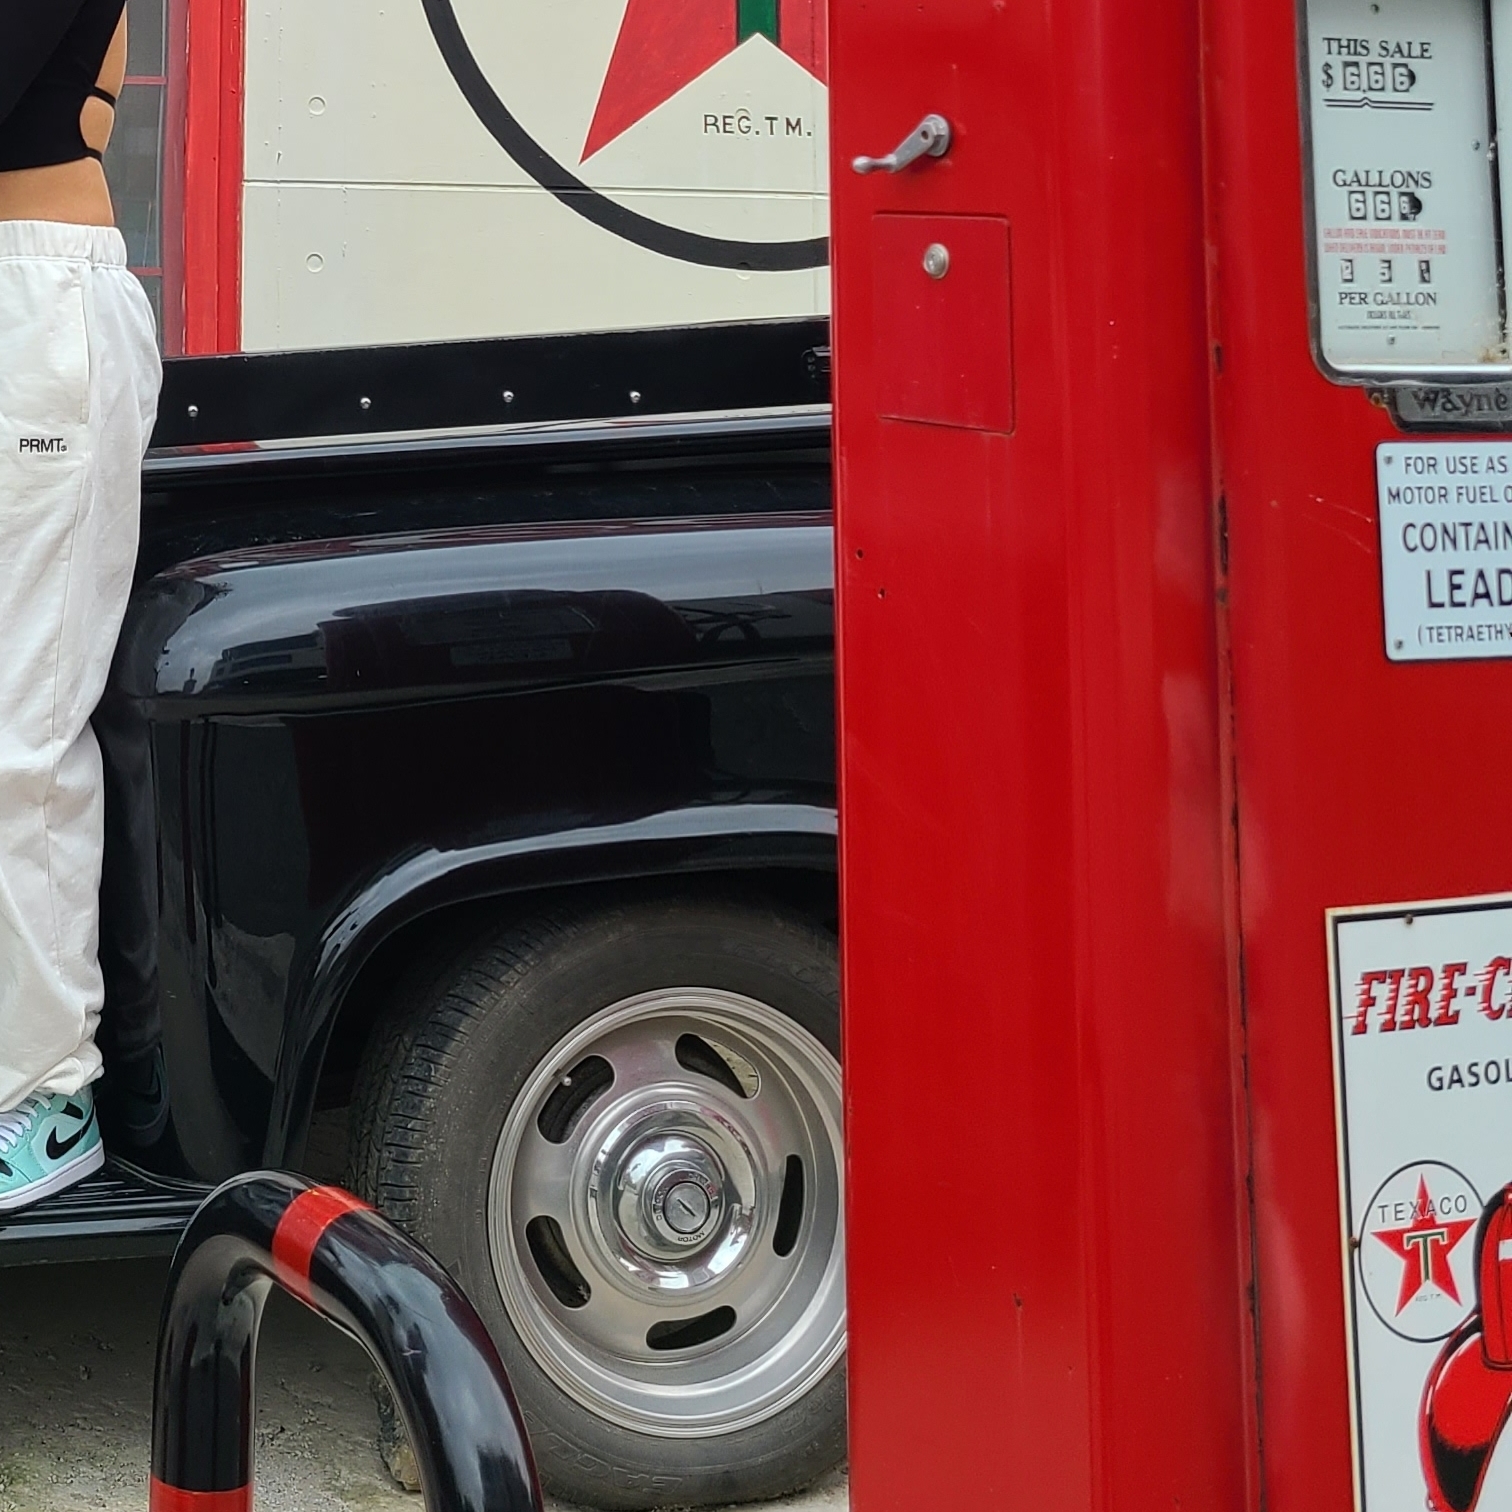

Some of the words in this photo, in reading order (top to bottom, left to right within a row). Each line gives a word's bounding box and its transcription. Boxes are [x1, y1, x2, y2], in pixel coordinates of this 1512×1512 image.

[1322, 37, 1370, 57] THIS
[1378, 40, 1433, 59] SALE
[1332, 168, 1433, 189] GALLONS
[1338, 292, 1369, 306] PER
[1373, 292, 1437, 306] GALLON
[1404, 456, 1438, 475] FOR
[1446, 455, 1479, 475] USE
[1485, 455, 1508, 474] AS
[1387, 486, 1449, 505] MOTOR
[1456, 485, 1499, 504] FUEL
[1425, 567, 1512, 609] LEAD
[1350, 956, 1512, 1036] FIRE-C
[1377, 1194, 1467, 1223] TEXACO
[1405, 1229, 1447, 1283] T
